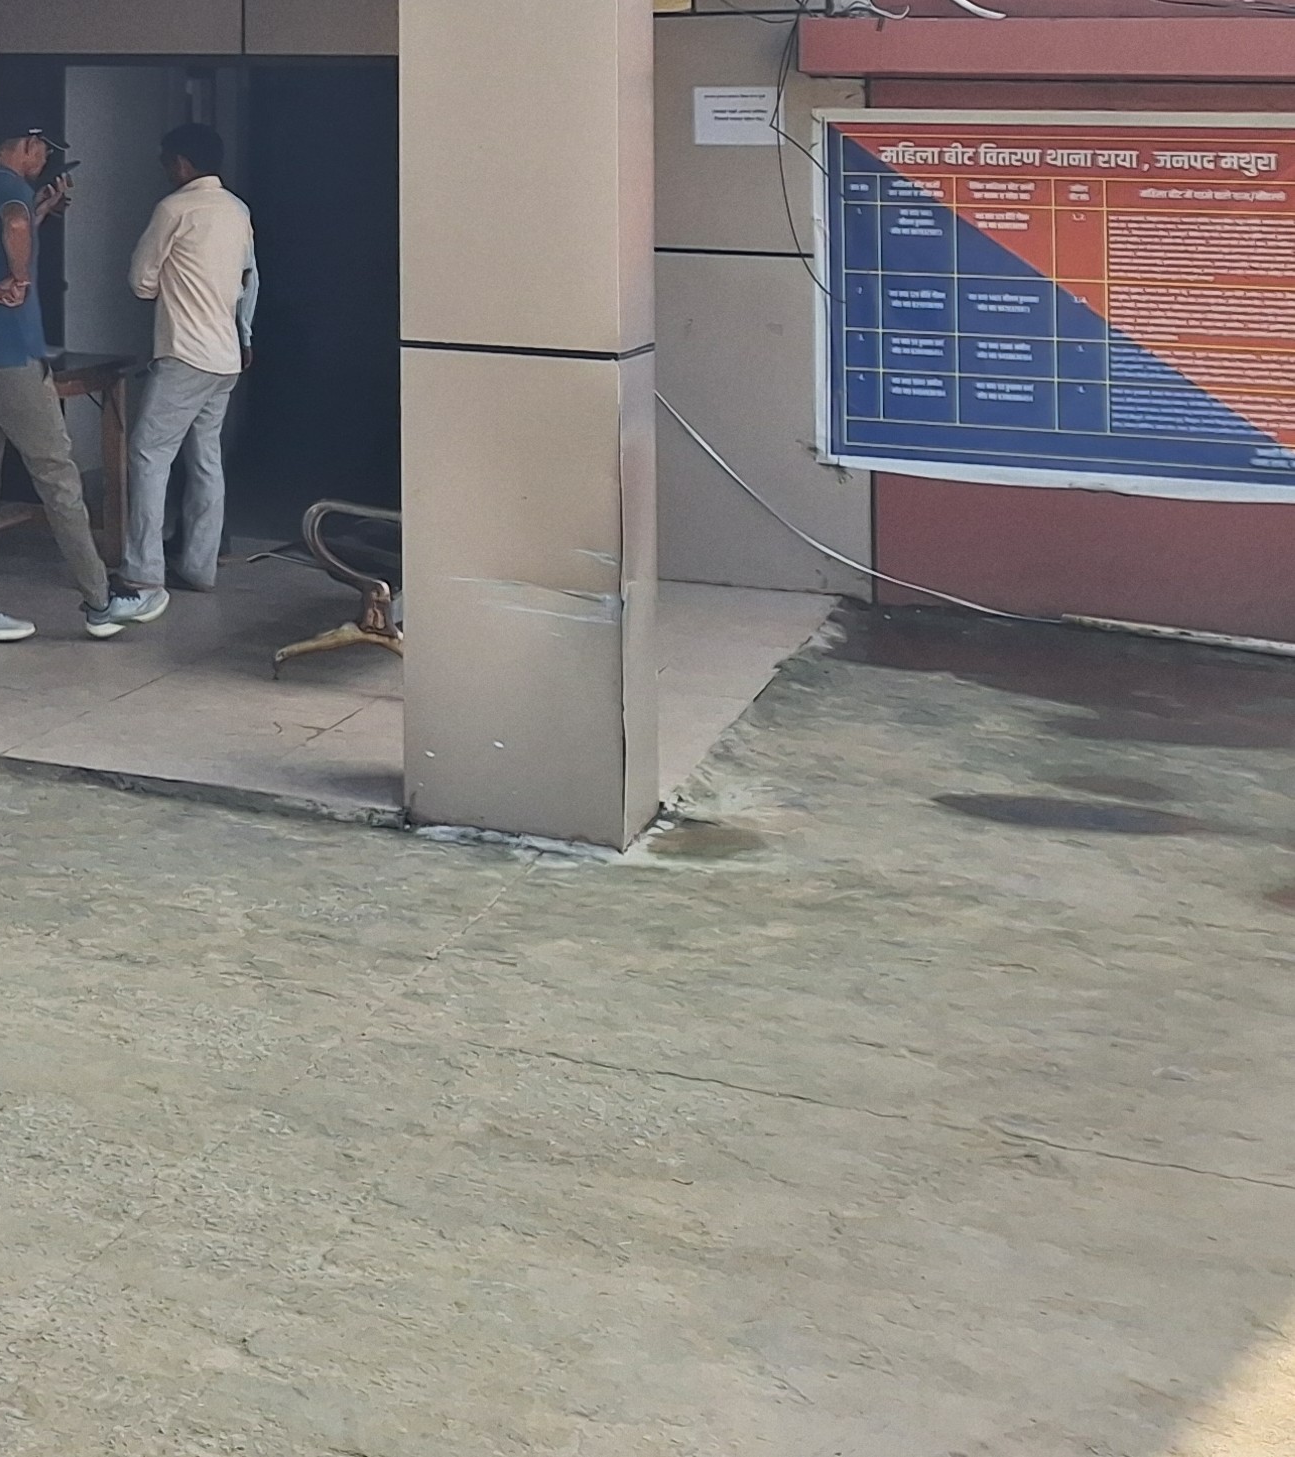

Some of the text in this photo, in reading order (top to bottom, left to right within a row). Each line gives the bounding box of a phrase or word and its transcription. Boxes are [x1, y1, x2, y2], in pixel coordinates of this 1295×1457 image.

[879, 141, 941, 165] महिला
[942, 143, 976, 166] बीट
[979, 143, 1042, 167] वितरण
[1046, 148, 1093, 168] थाना
[1095, 149, 1139, 169] राया
[1152, 151, 1217, 170] जनपद
[1218, 152, 1279, 177] मथुरा
